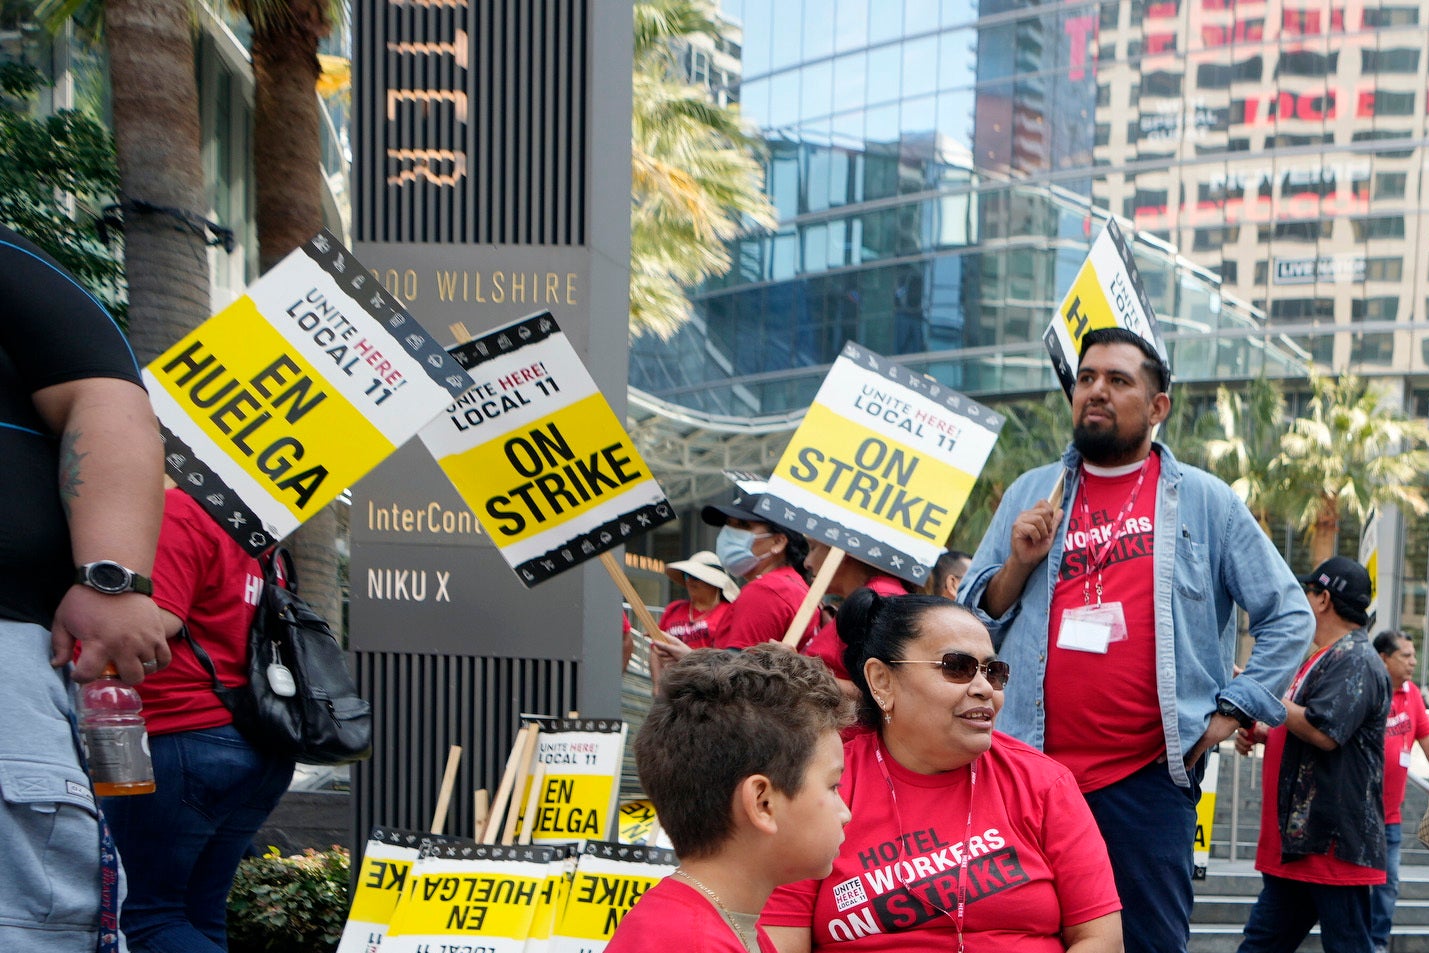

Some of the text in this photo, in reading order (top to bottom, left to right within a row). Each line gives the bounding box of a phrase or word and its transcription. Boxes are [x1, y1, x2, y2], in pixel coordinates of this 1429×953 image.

[387, 0, 468, 188] TER
[436, 269, 579, 305] WILSHIRE
[1110, 281, 1134, 331] LOC
[286, 299, 393, 407] LOCAL 11
[305, 288, 406, 391] UNITE HERE!
[249, 353, 328, 425] EN
[499, 362, 549, 390] HERE!
[162, 340, 329, 510] HUELGA
[451, 377, 560, 431] LOCAL 11
[854, 396, 958, 452] LOCAL 11
[862, 384, 962, 437] UNITE HERE!
[504, 422, 575, 477] ON
[854, 437, 920, 487] ON
[485, 442, 642, 536] STRIKE
[789, 447, 948, 541] STRIKE
[1068, 509, 1115, 531] OEL
[1065, 533, 1154, 577] SIKE
[368, 568, 451, 602] NIKU X
[538, 753, 597, 765] LOCAL 11
[540, 743, 568, 753] UNITE
[544, 779, 574, 804] EN
[858, 828, 949, 870] HOTEL
[863, 828, 1006, 895] WORKERS
[424, 876, 538, 906] HUELGA
[577, 875, 652, 907] RIKE
[828, 852, 1024, 942] ON STRIKE
[835, 879, 860, 896] UNITE
[836, 887, 863, 904] HERE!
[838, 898, 858, 910] LOCAL
[446, 905, 487, 931] EN
